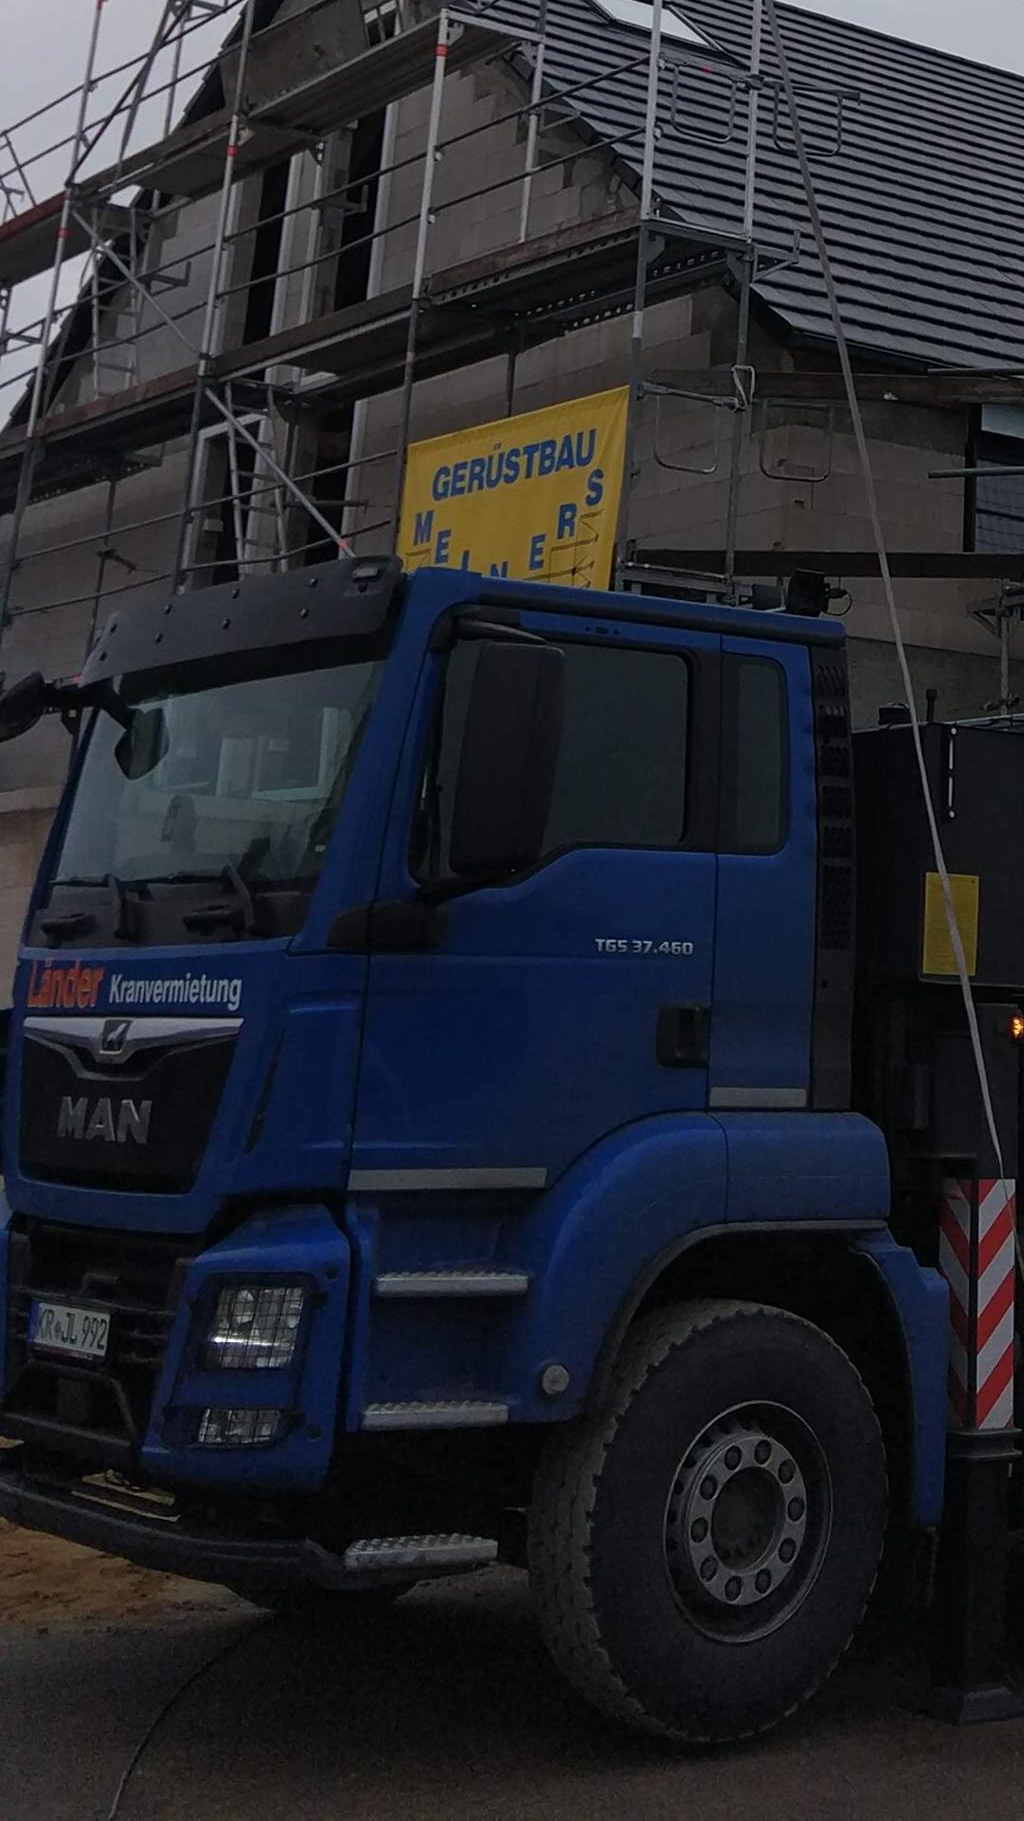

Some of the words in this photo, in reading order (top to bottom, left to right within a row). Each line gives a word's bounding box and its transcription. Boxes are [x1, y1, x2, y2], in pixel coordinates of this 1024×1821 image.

[432, 429, 597, 501] GERÜSTBAU
[595, 938, 628, 954] TGS
[631, 940, 695, 956] 37.460
[27, 957, 106, 1009] Länder
[108, 972, 243, 1012] Kranvermietung
[56, 1094, 153, 1145] MAN
